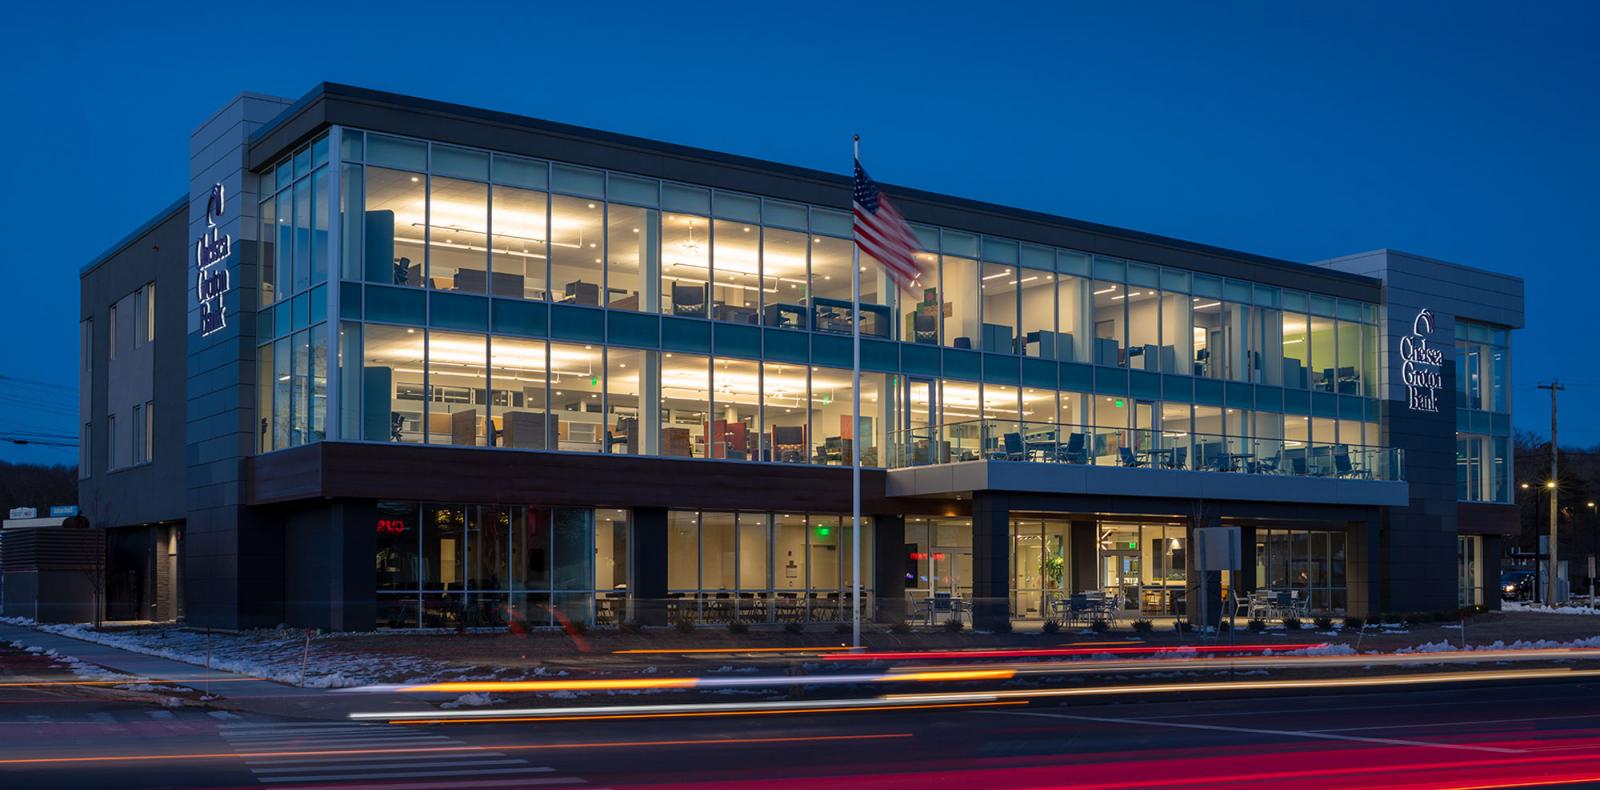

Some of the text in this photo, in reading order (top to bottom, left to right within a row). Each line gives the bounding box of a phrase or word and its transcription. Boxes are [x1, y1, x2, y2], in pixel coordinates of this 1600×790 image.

[1400, 336, 1442, 366] Chelsea
[1402, 360, 1442, 389] Groton
[1408, 385, 1440, 412] Bank
